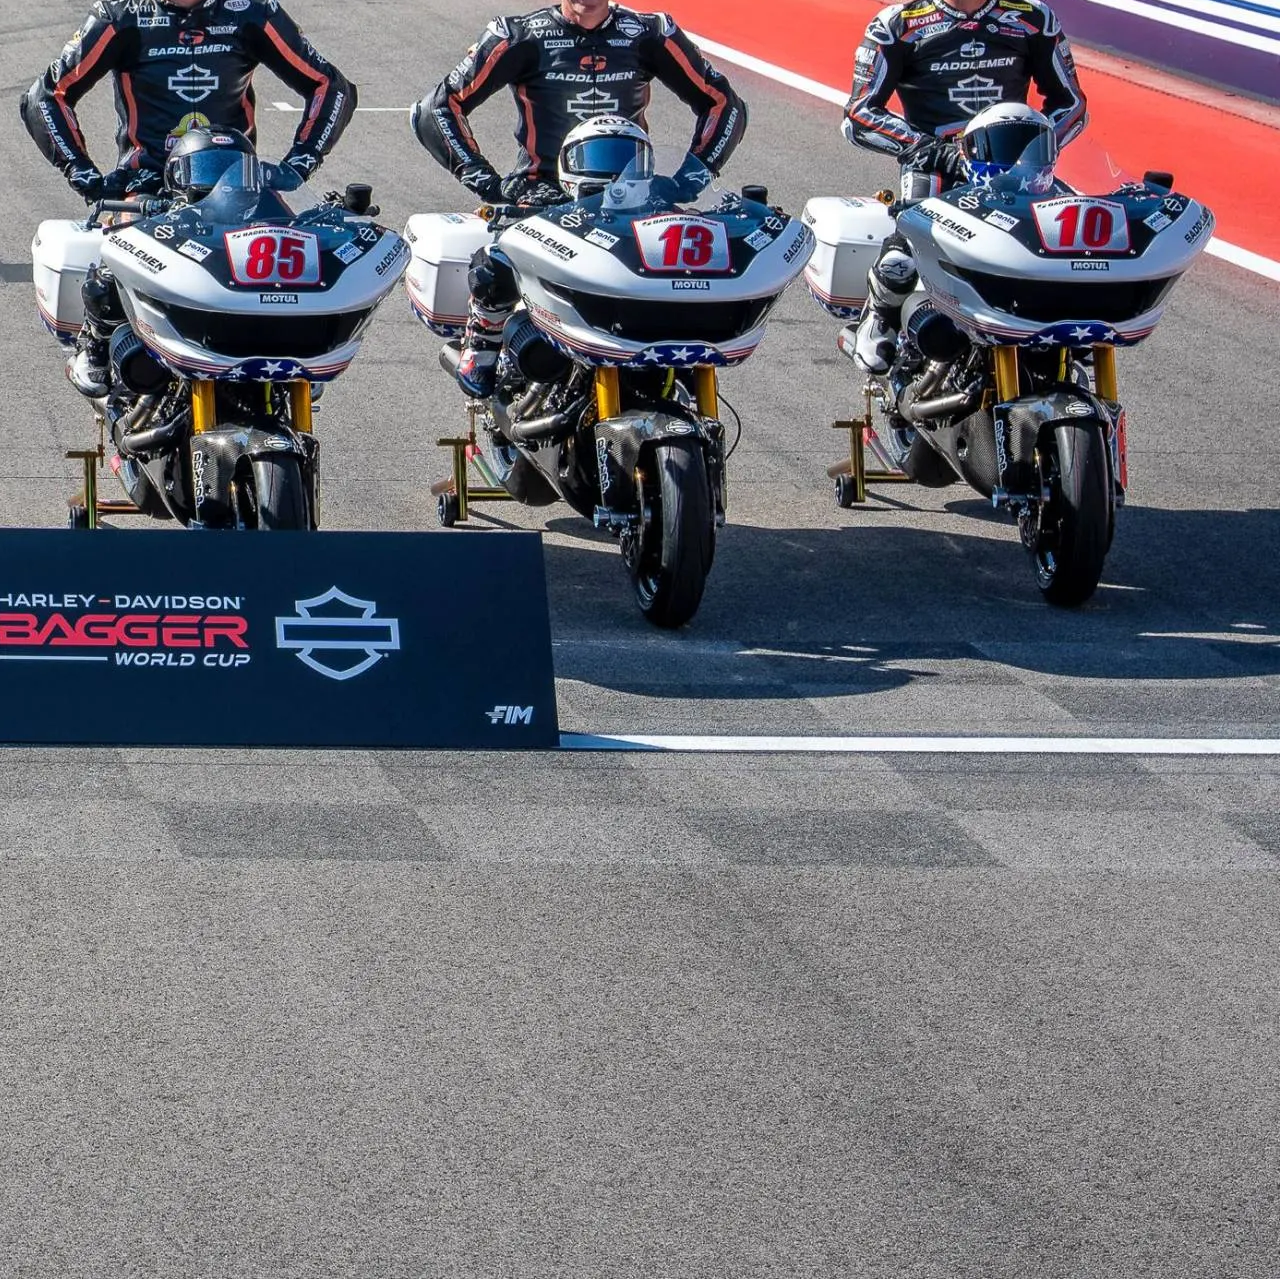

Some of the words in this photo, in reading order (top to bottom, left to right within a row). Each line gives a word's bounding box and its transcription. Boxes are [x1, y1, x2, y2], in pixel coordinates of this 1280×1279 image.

[909, 12, 942, 28] MOTUL
[148, 44, 231, 56] SADDLEMEN
[930, 57, 1015, 71] SADDLEMEN
[545, 71, 633, 83] SADDLEMEN
[314, 91, 345, 152] SADDLEMEN
[38, 101, 76, 161] SADDLEMEN
[434, 109, 472, 163] SADDLEMEN
[706, 107, 739, 163] SADDLEMEN
[1048, 198, 1095, 207] SADDLEMEN
[652, 216, 703, 224] SADDLEMEN
[914, 204, 977, 240] SADDLEMEN
[1053, 204, 1114, 247] 10
[242, 229, 290, 238] SADDLEMEN
[514, 222, 578, 260] SADDLEMEN
[109, 234, 167, 272] SADDLEMEN
[658, 223, 715, 266] 13
[245, 235, 307, 280] 85
[1073, 262, 1107, 270] MOTUL
[674, 281, 708, 289] MOTUL
[262, 294, 297, 303] MOTUL
[115, 652, 196, 667] WORLD
[203, 652, 251, 667] CUP
[486, 705, 534, 724] FIM
